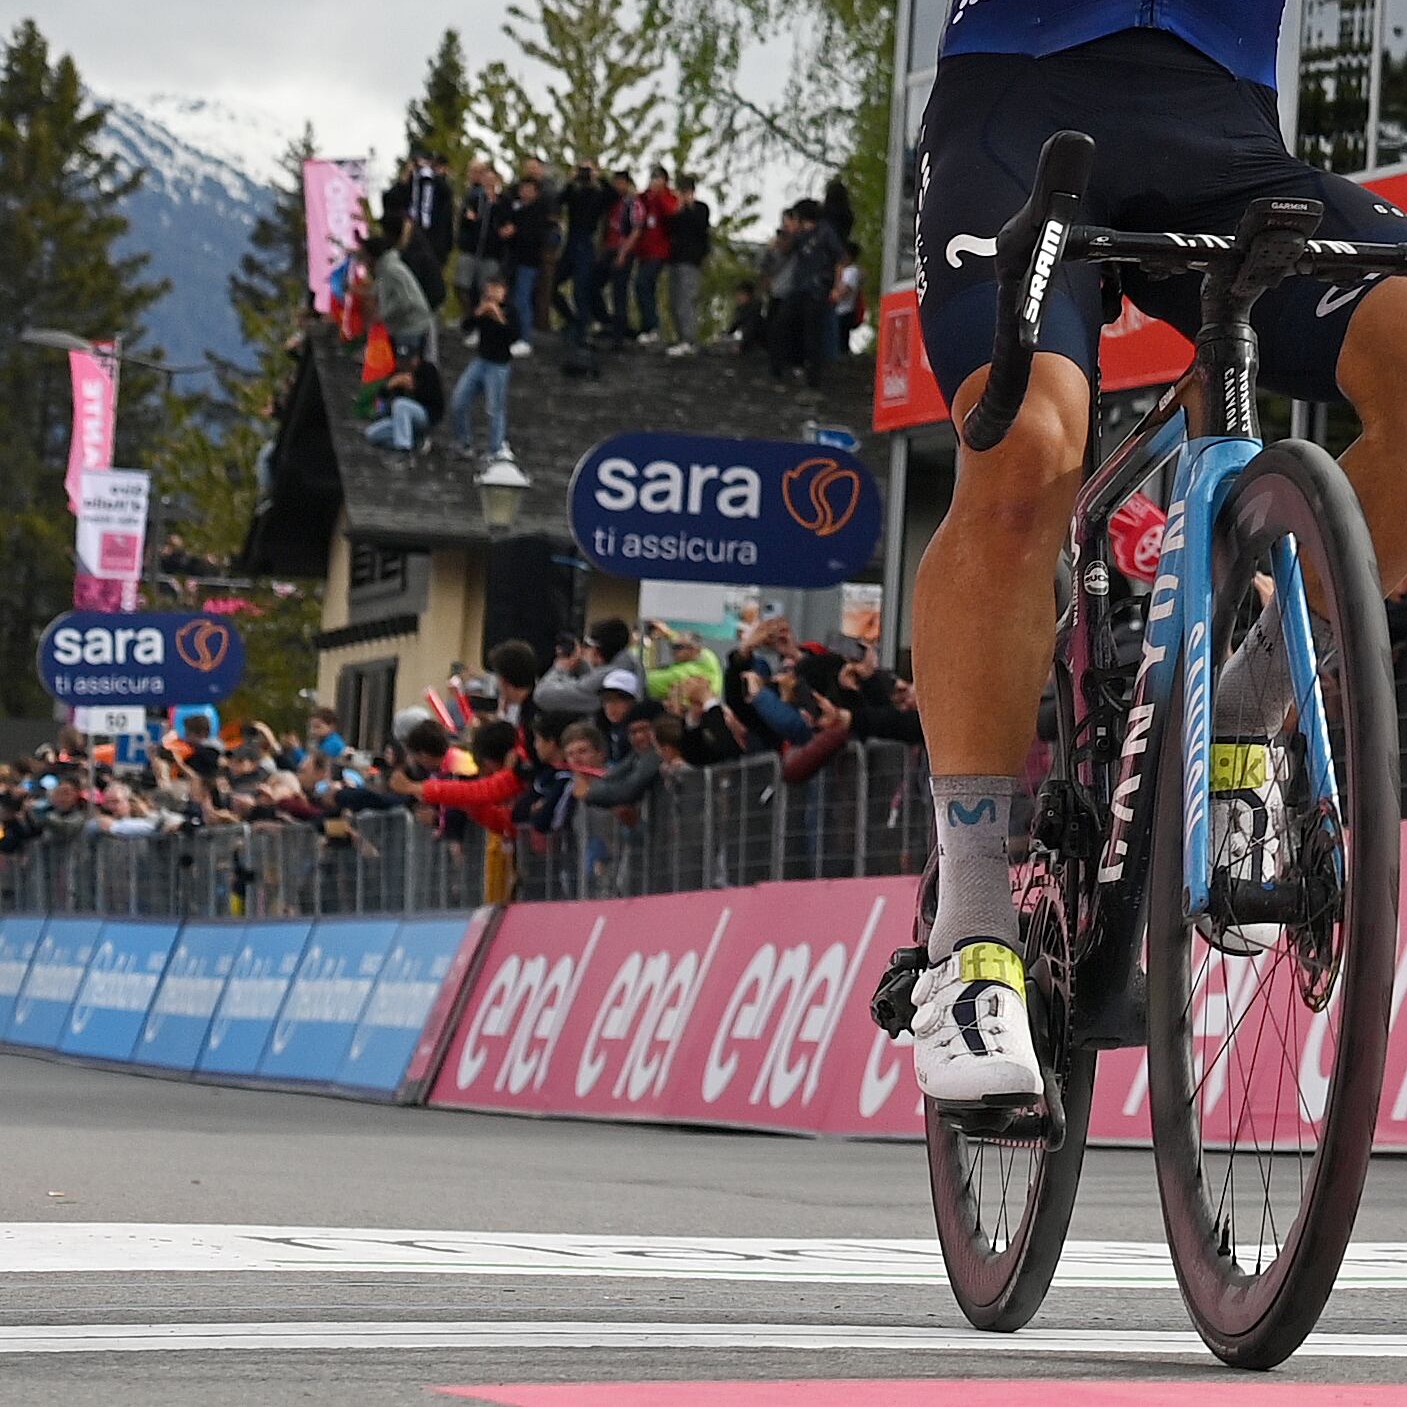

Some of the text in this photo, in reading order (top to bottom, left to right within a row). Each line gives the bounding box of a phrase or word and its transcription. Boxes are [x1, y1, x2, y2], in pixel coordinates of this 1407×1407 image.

[1271, 201, 1309, 211] GARMIN
[1022, 219, 1065, 324] SRAM
[1224, 367, 1238, 432] CANYON
[594, 456, 762, 520] sara
[592, 526, 758, 567] ti assicura
[53, 624, 165, 666] sara
[54, 675, 165, 695] ti assicura
[1098, 498, 1186, 883] CANYON
[457, 915, 607, 1094] enel
[574, 907, 732, 1103] enel
[701, 896, 887, 1110] enel
